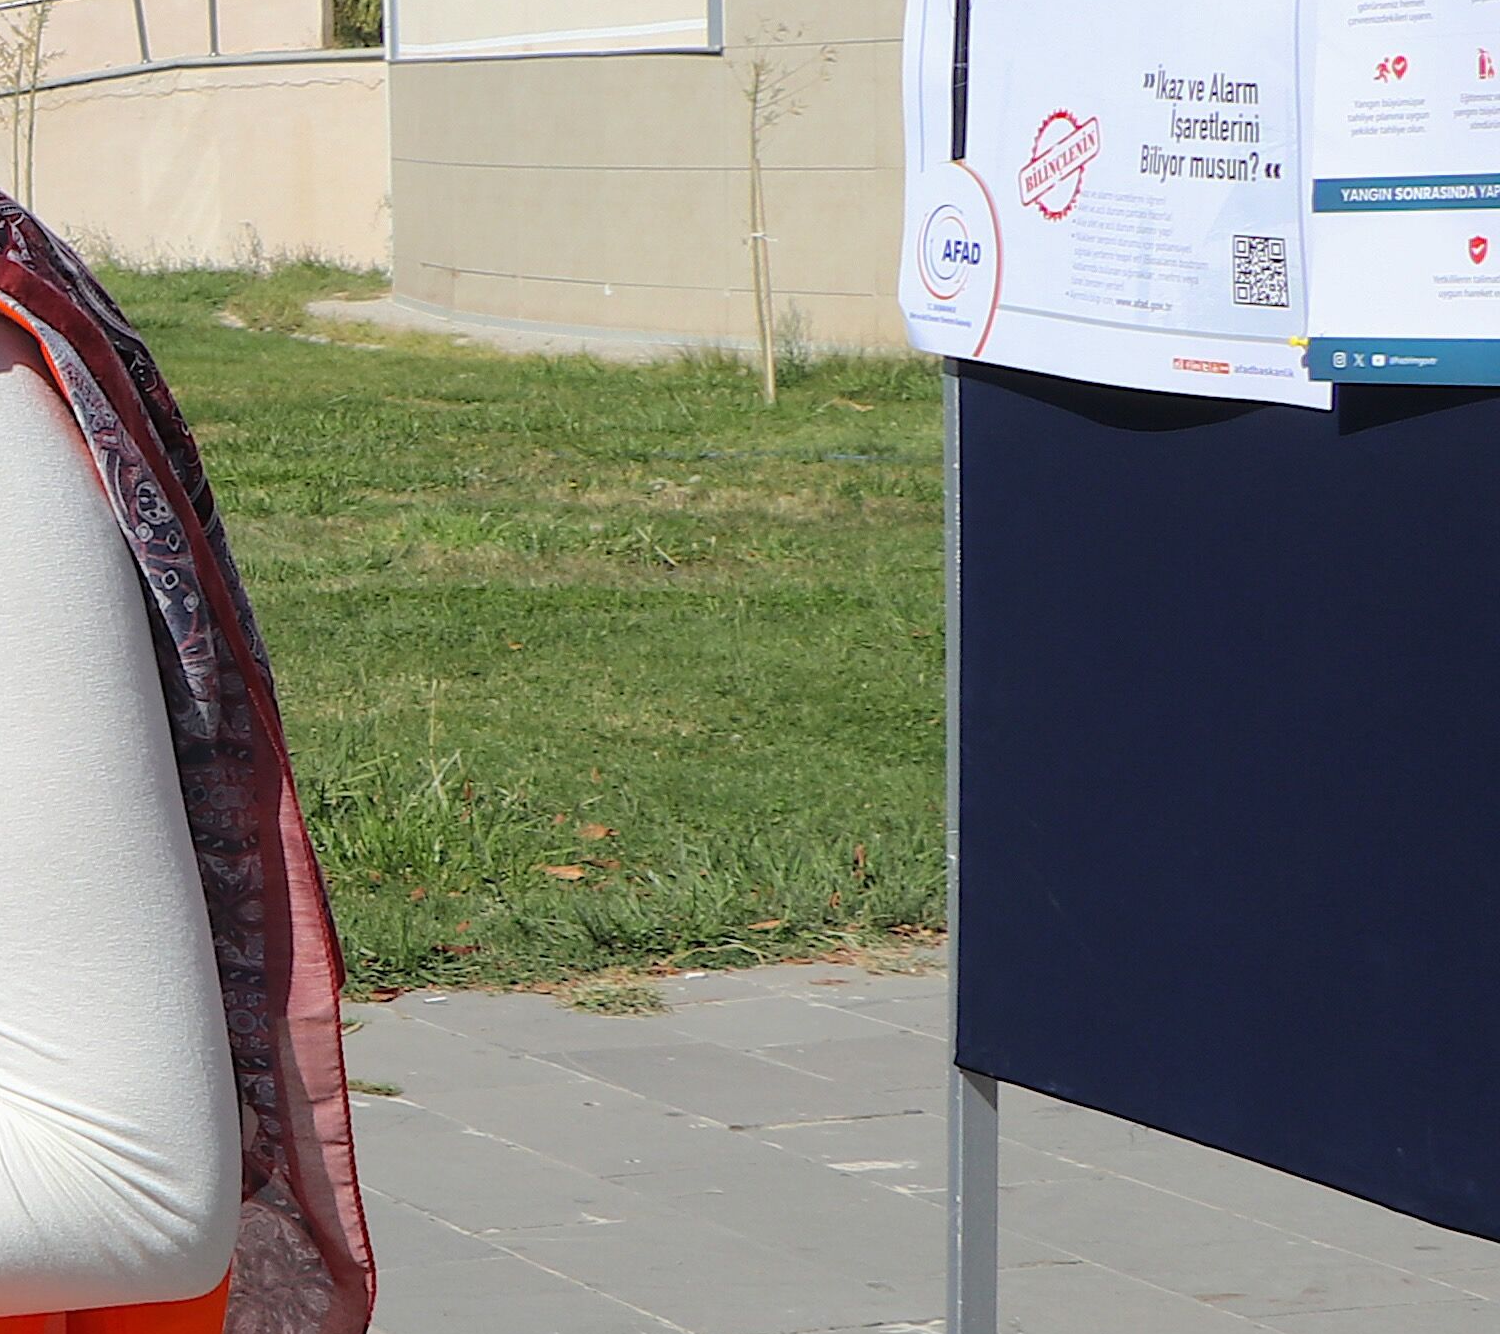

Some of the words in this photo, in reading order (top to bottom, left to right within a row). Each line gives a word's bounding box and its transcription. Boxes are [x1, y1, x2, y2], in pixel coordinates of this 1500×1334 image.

[1188, 78, 1205, 102] ve
[1208, 72, 1259, 104] Alarm
[1170, 103, 1260, 144] İşaretlerini
[1024, 130, 1097, 193] BİLİNÇLENİN
[1140, 144, 1186, 183] Biliyor
[1189, 152, 1259, 182] musun?
[1341, 188, 1392, 202] YANGIN
[1395, 185, 1476, 200] SONRASINDA
[941, 239, 982, 265] AFAD
